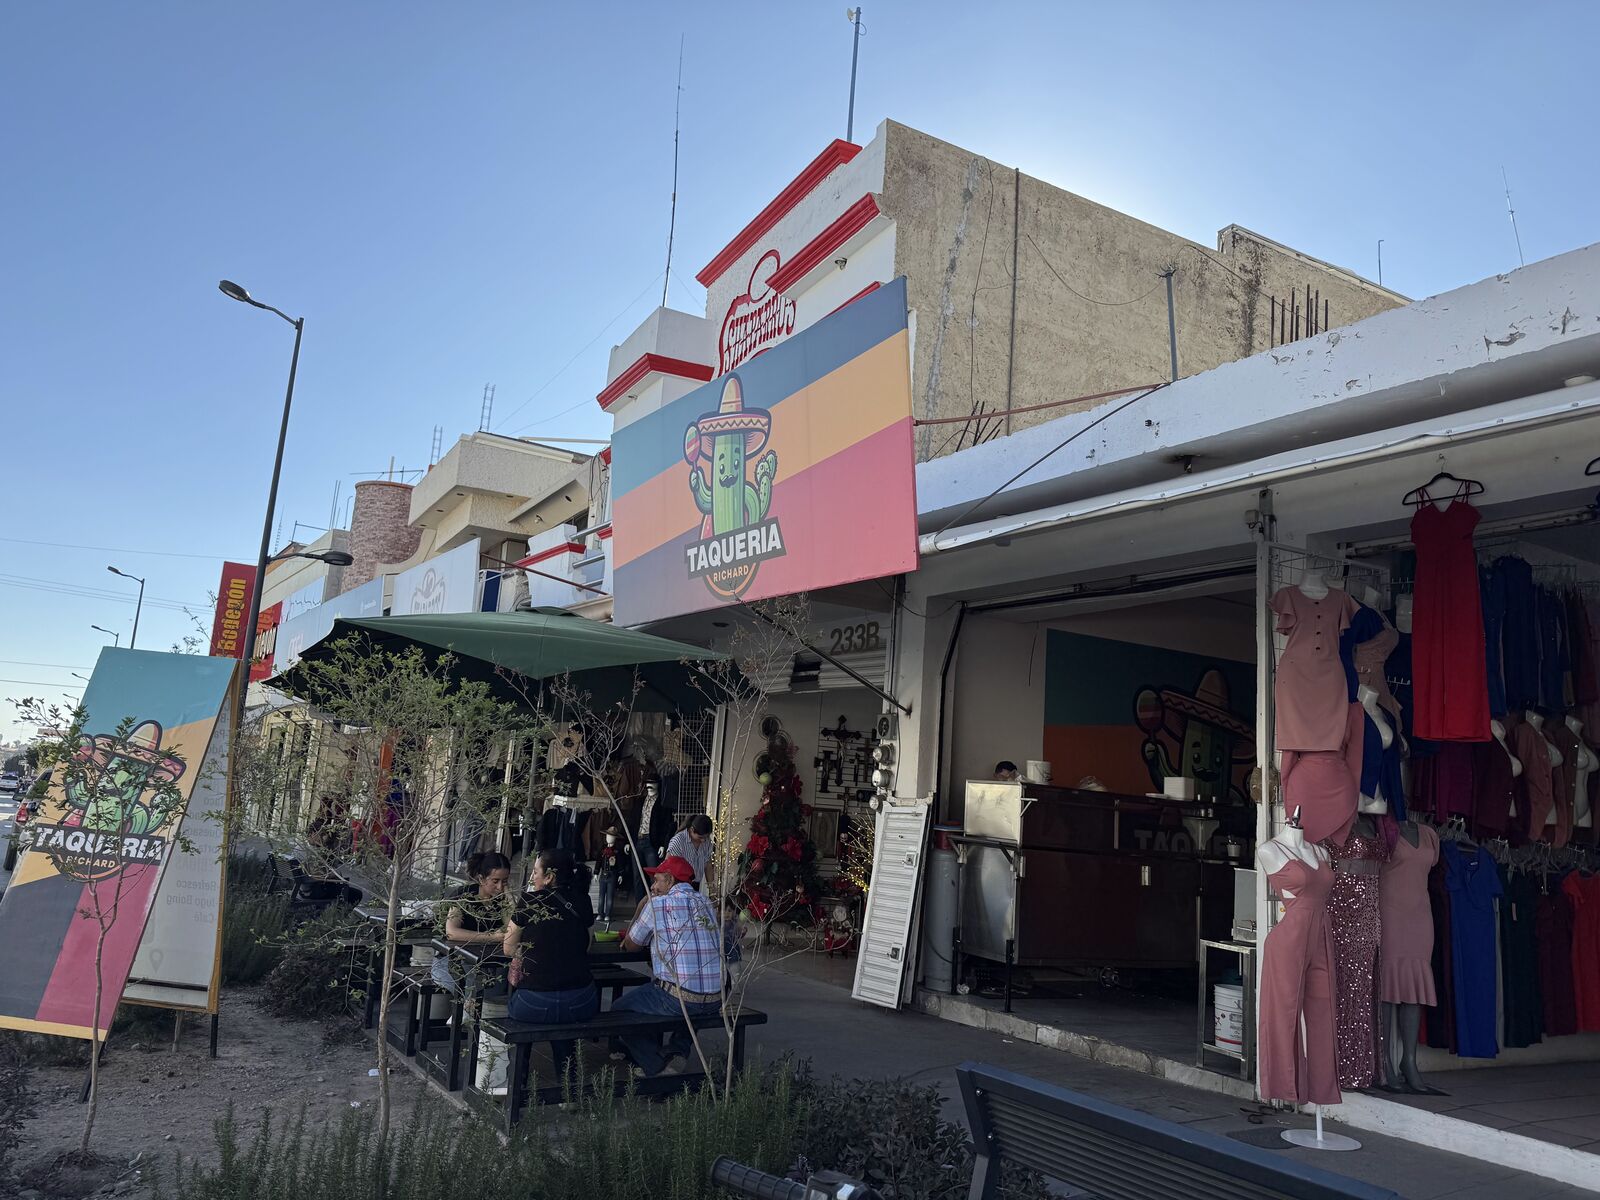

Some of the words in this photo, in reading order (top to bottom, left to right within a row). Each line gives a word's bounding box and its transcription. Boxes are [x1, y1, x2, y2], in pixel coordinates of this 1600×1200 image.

[687, 523, 782, 573] TAQUERIA
[713, 564, 749, 583] RICHARD
[217, 578, 246, 650] Bodegón
[830, 621, 881, 655] 233B
